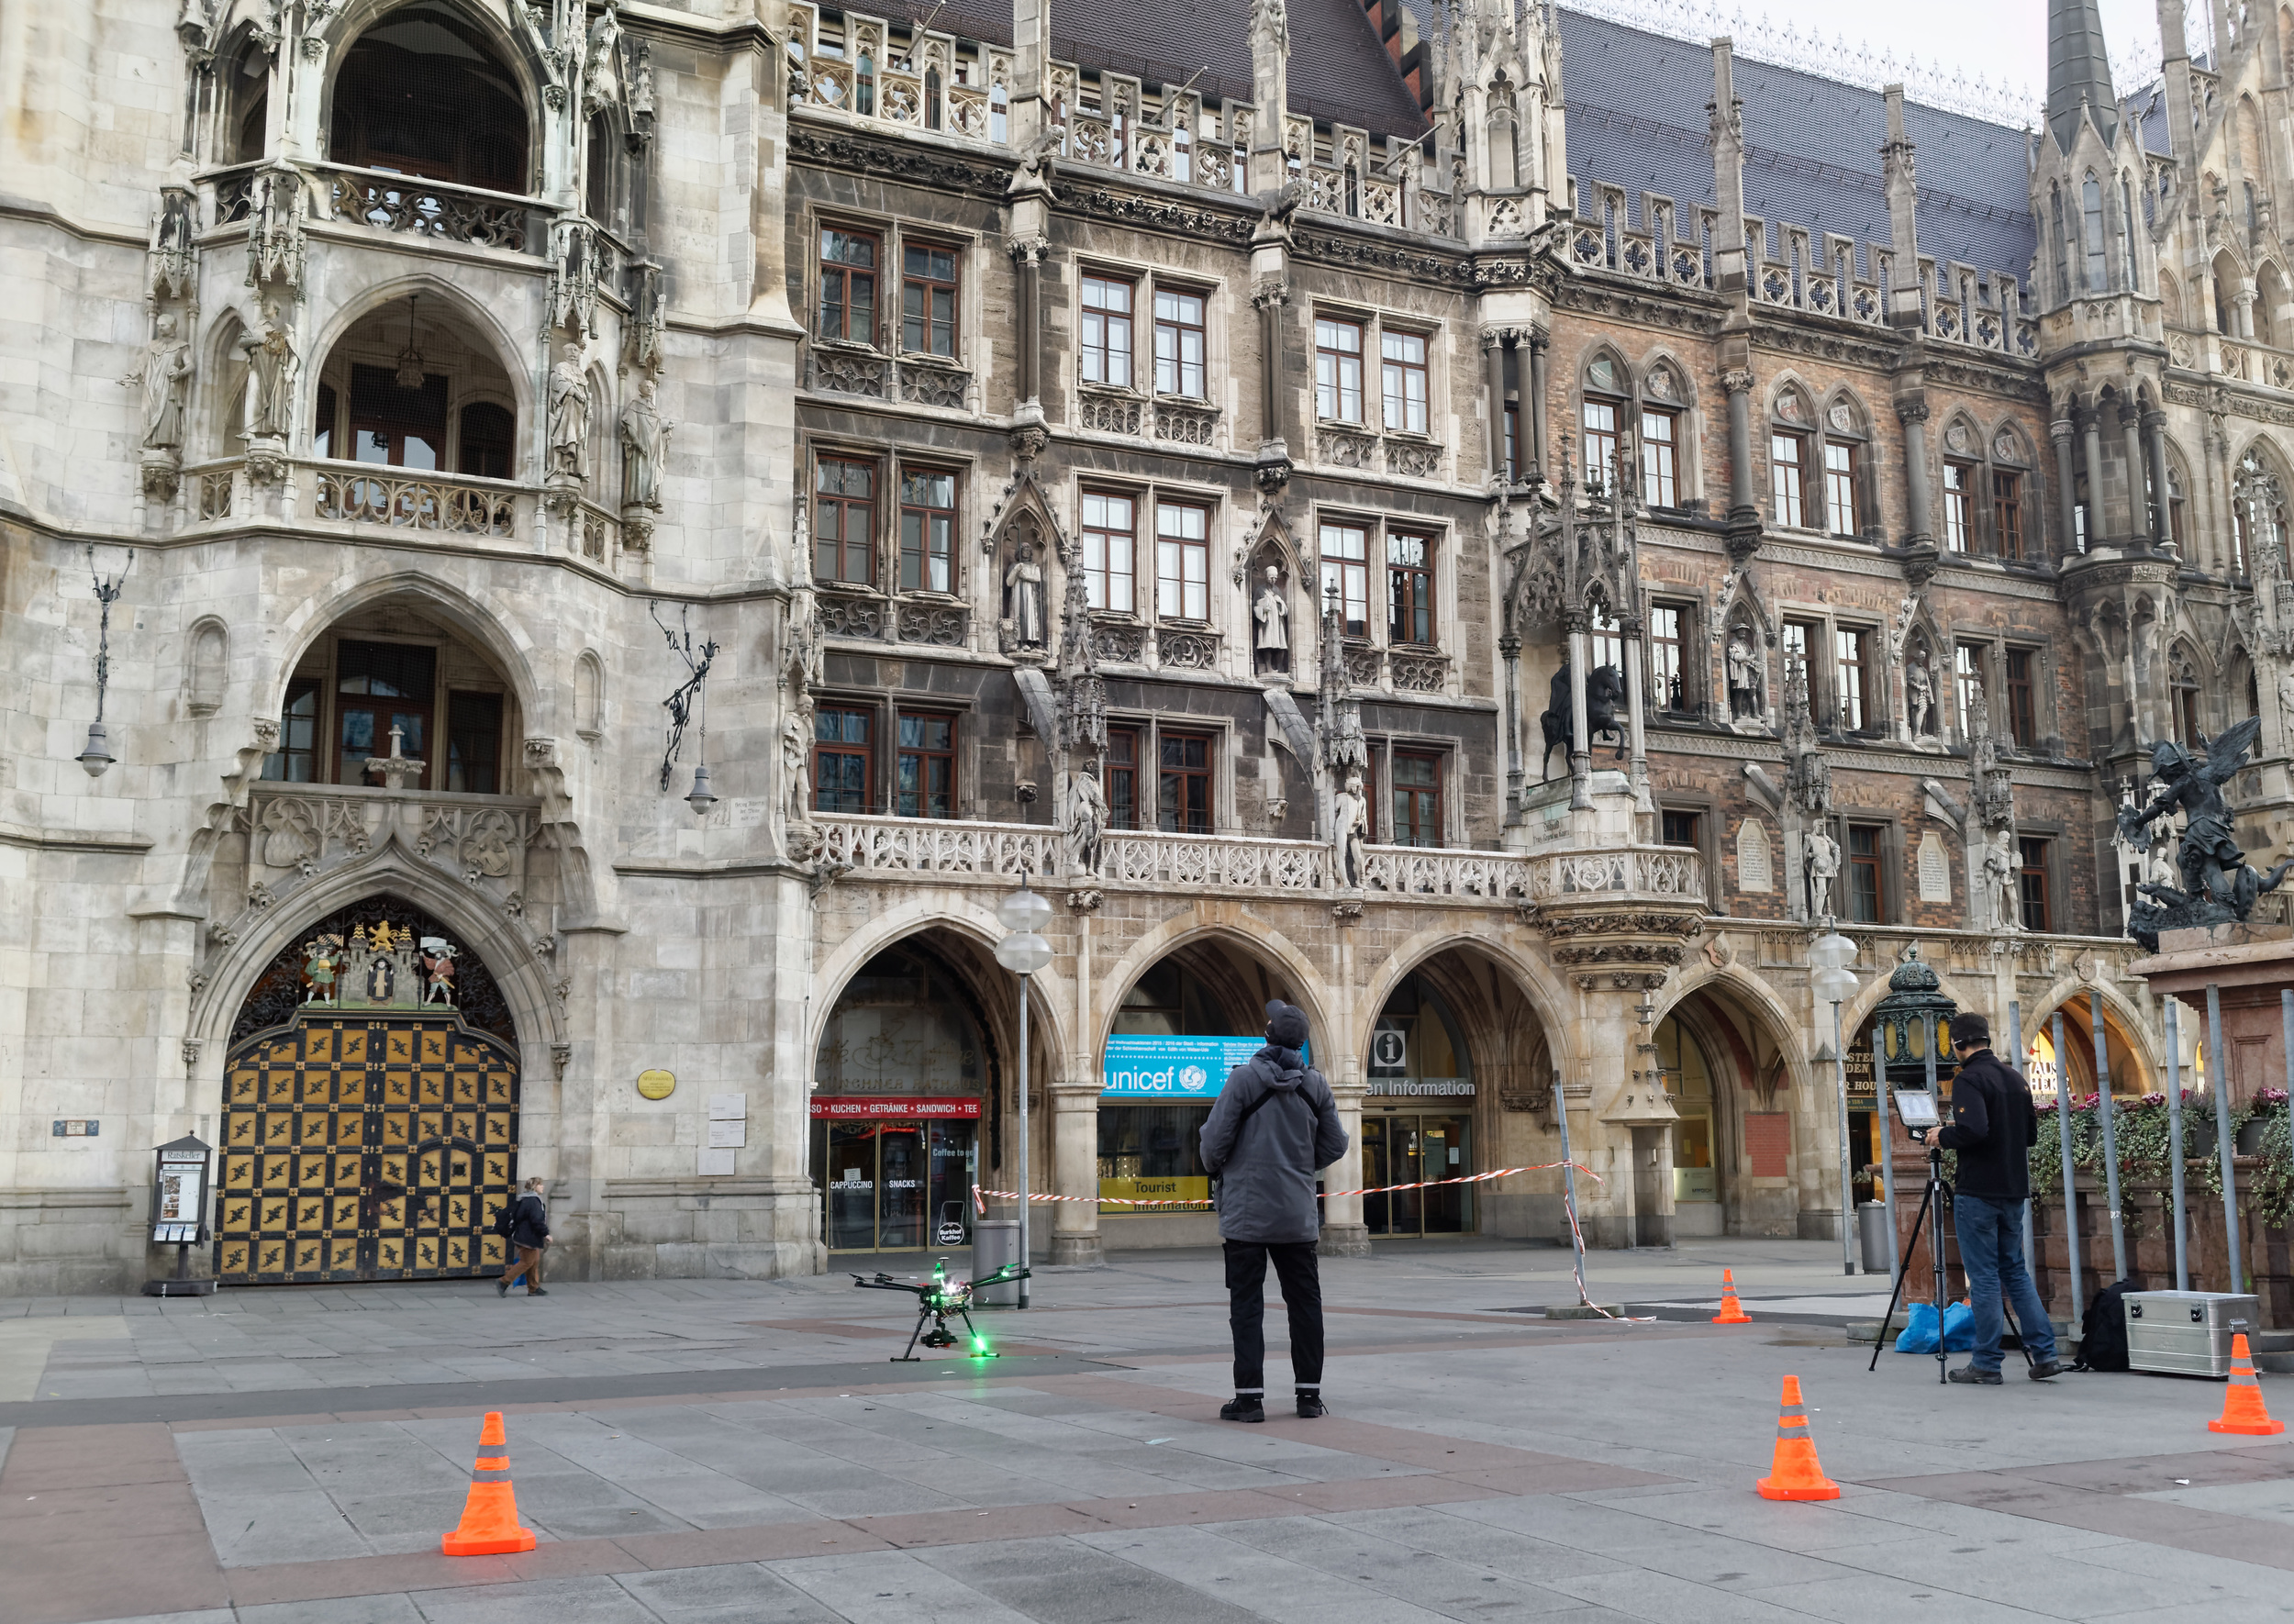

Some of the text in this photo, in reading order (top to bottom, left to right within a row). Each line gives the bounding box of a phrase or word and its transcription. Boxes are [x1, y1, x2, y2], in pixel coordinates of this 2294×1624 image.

[1103, 1066, 1175, 1091] unicef
[1389, 1080, 1476, 1096] Information
[1854, 1082, 1890, 1091] HOUE
[830, 1104, 862, 1113] KUCHEN
[869, 1102, 908, 1113] GETRÄNKE
[916, 1104, 956, 1113] SANDWICH
[963, 1104, 977, 1113] TEE
[167, 1151, 200, 1160] Ratskeller
[932, 1148, 956, 1157] Coffee
[957, 1149, 964, 1157] to
[830, 1180, 873, 1190] CAPPUCCINO
[888, 1179, 916, 1188] SNACKS
[1133, 1181, 1176, 1193] Tourist
